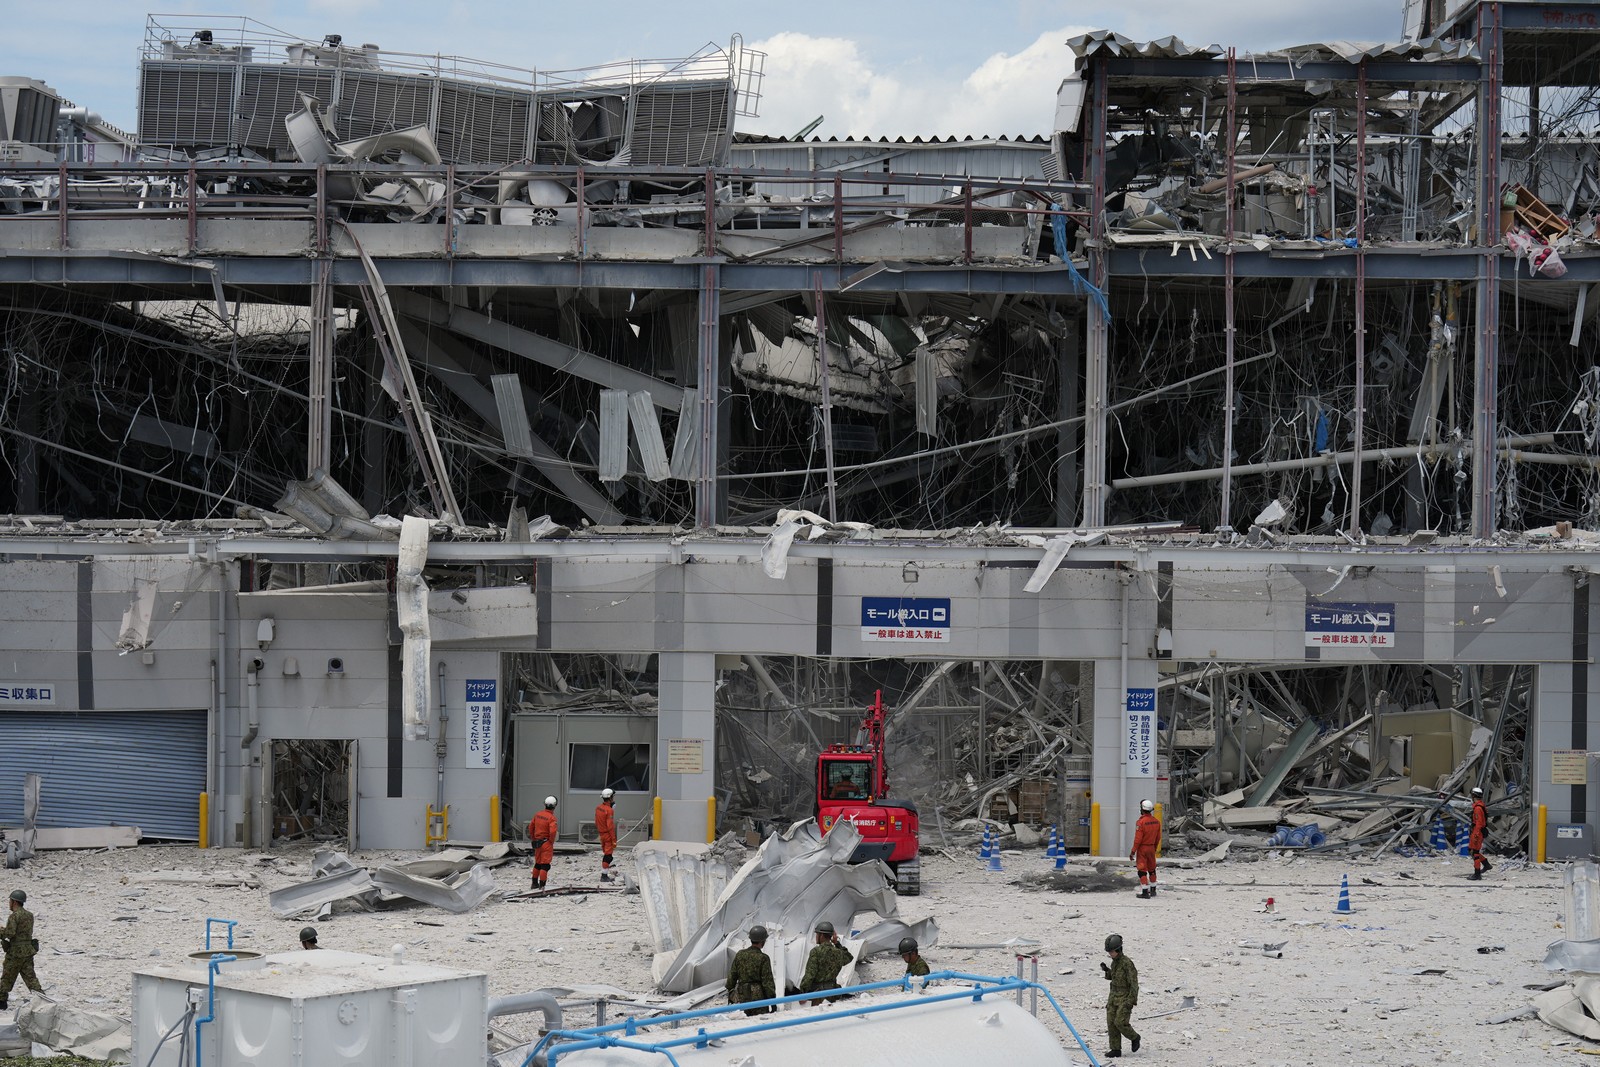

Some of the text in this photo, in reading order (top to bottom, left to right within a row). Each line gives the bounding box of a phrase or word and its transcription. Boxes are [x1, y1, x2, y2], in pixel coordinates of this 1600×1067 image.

[867, 608, 929, 620] モール搬入口
[1310, 613, 1374, 625] モール搬入口
[868, 629, 943, 639] 一般車は進入禁止
[1312, 635, 1387, 644] 一般車は進入禁止
[0, 688, 51, 700] ミ収集口
[470, 705, 480, 751] 切ってください
[482, 705, 492, 765] 納品時はエンジンを
[1128, 714, 1138, 761] 切ってください
[1140, 715, 1150, 774] 納品時はエンジンを
